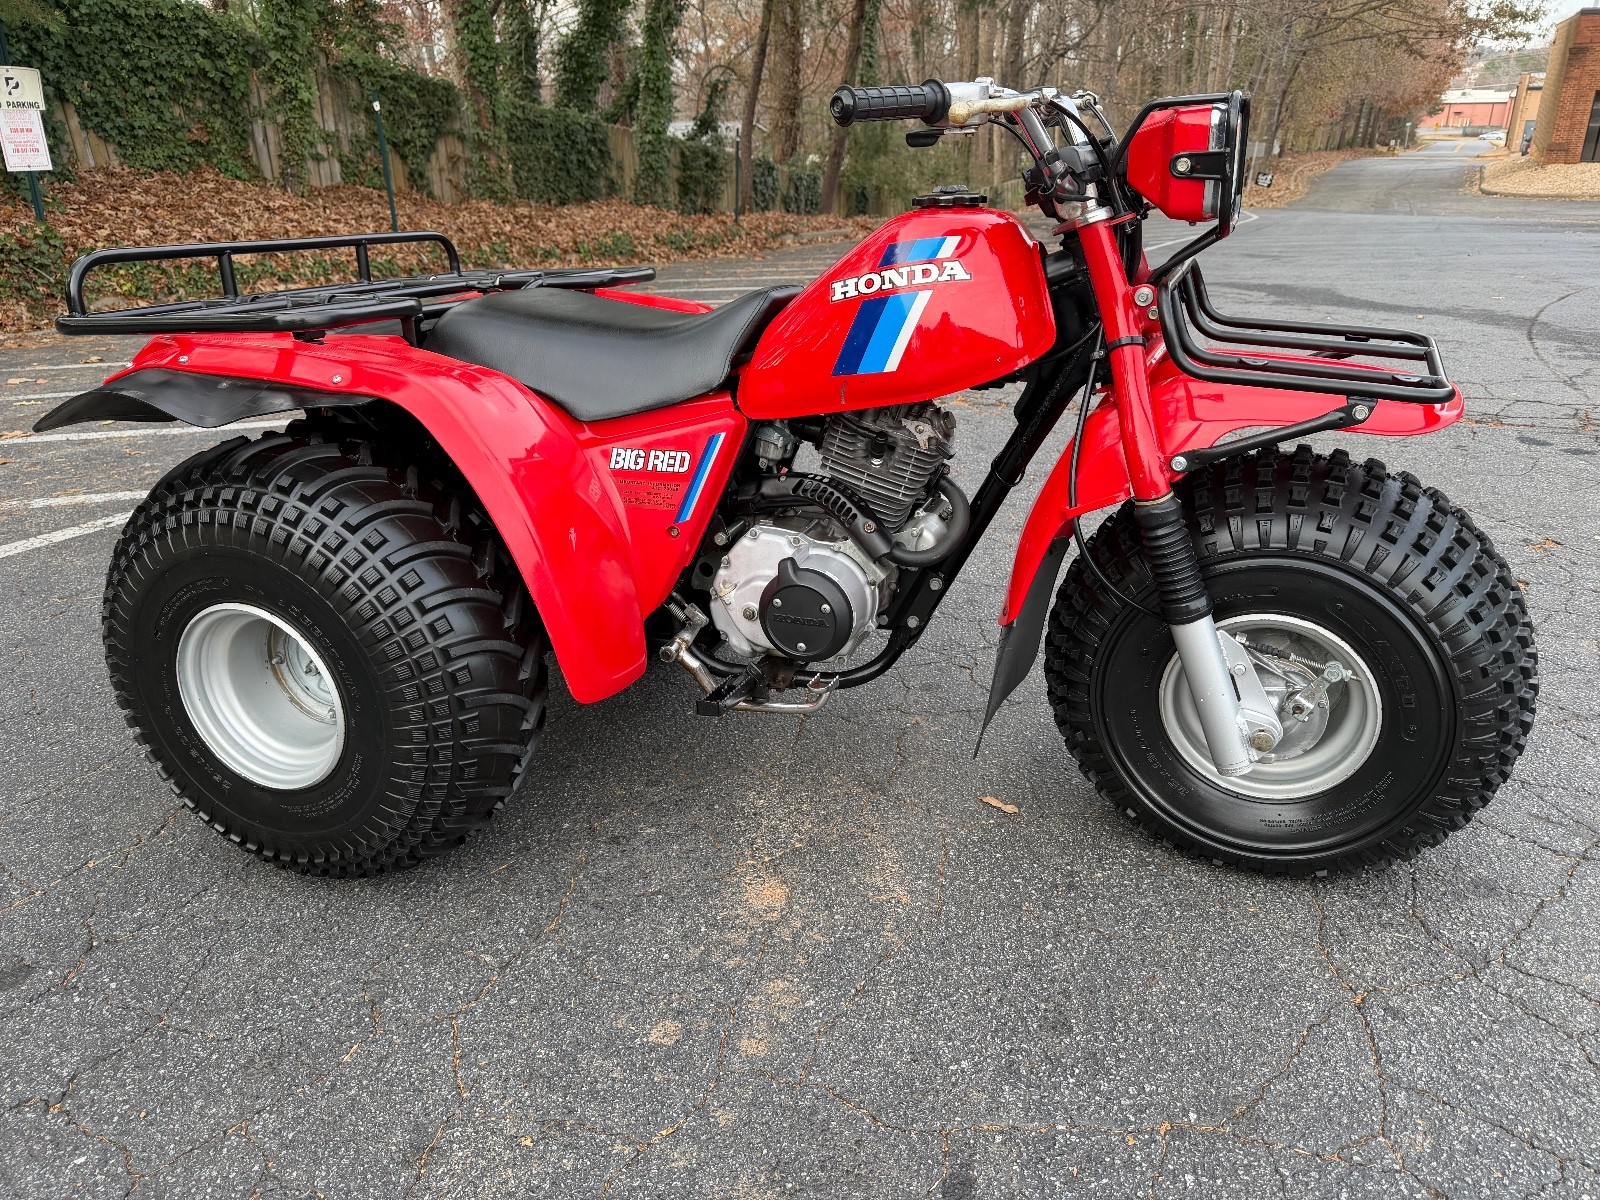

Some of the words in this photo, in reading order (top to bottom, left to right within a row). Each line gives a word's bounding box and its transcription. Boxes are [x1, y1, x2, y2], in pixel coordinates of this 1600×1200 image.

[6, 100, 40, 109] PARKING
[831, 260, 972, 302] HONDA
[609, 447, 646, 470] BIG
[646, 449, 691, 473] RED
[773, 613, 829, 627] HONDA
